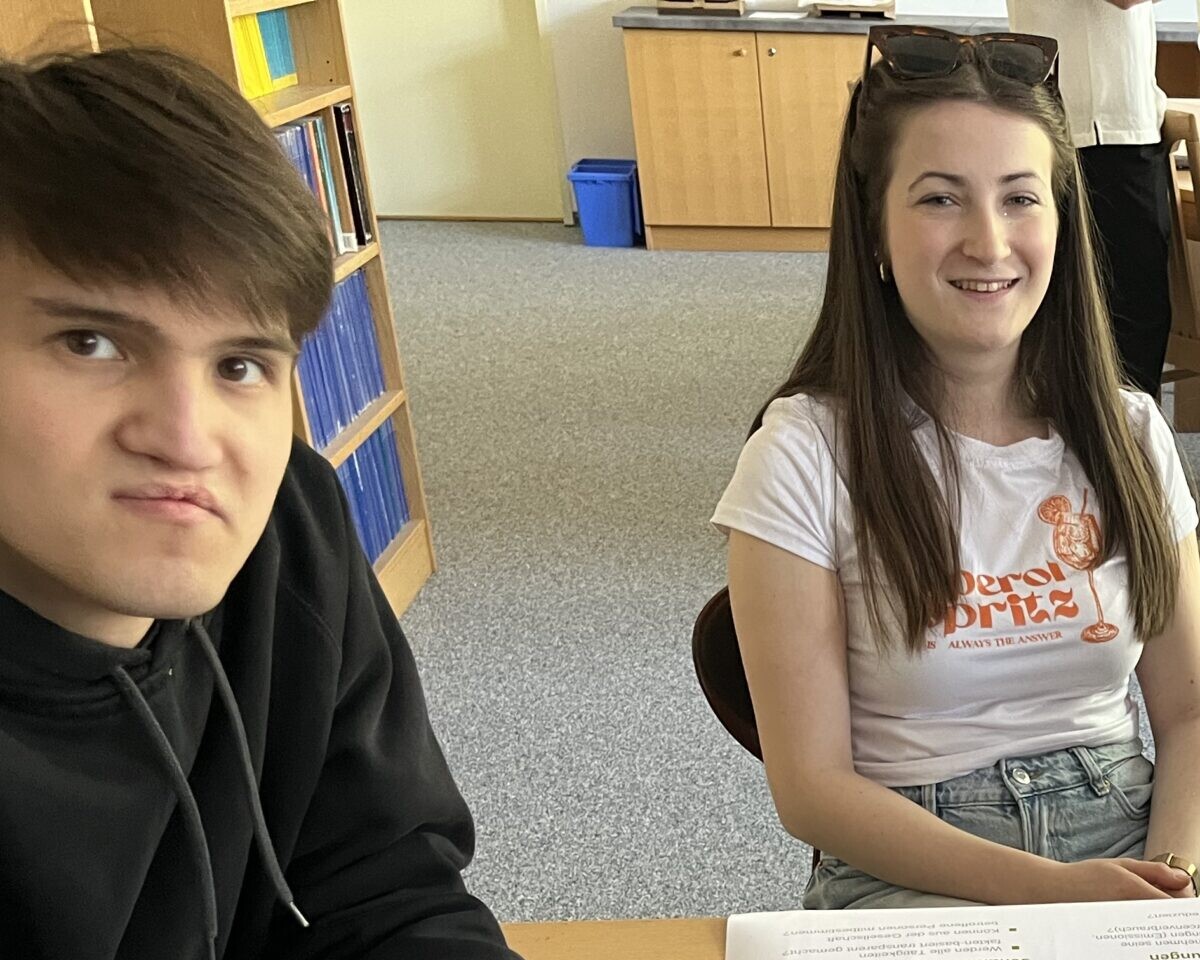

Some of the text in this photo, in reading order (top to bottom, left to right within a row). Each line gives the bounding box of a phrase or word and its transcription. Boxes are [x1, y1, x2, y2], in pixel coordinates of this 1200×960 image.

[948, 638, 991, 649] ALWAYS
[996, 636, 1015, 646] THE
[1017, 630, 1063, 645] ANSWER
